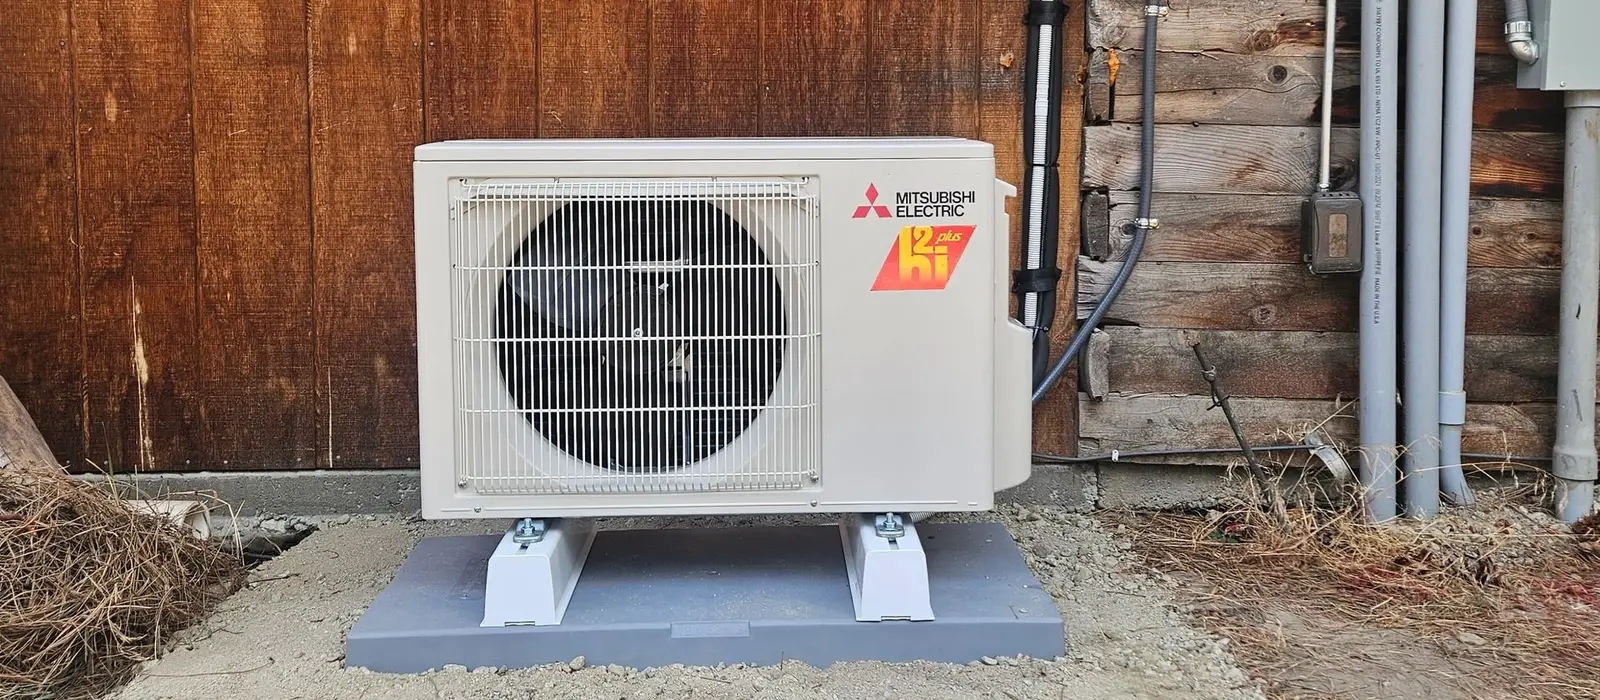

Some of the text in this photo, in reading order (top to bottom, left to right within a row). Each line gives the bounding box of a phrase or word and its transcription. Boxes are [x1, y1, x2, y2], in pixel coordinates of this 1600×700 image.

[896, 191, 975, 204] MITSUBISHI
[896, 205, 965, 218] ELECTRIC
[935, 230, 963, 244] plus
